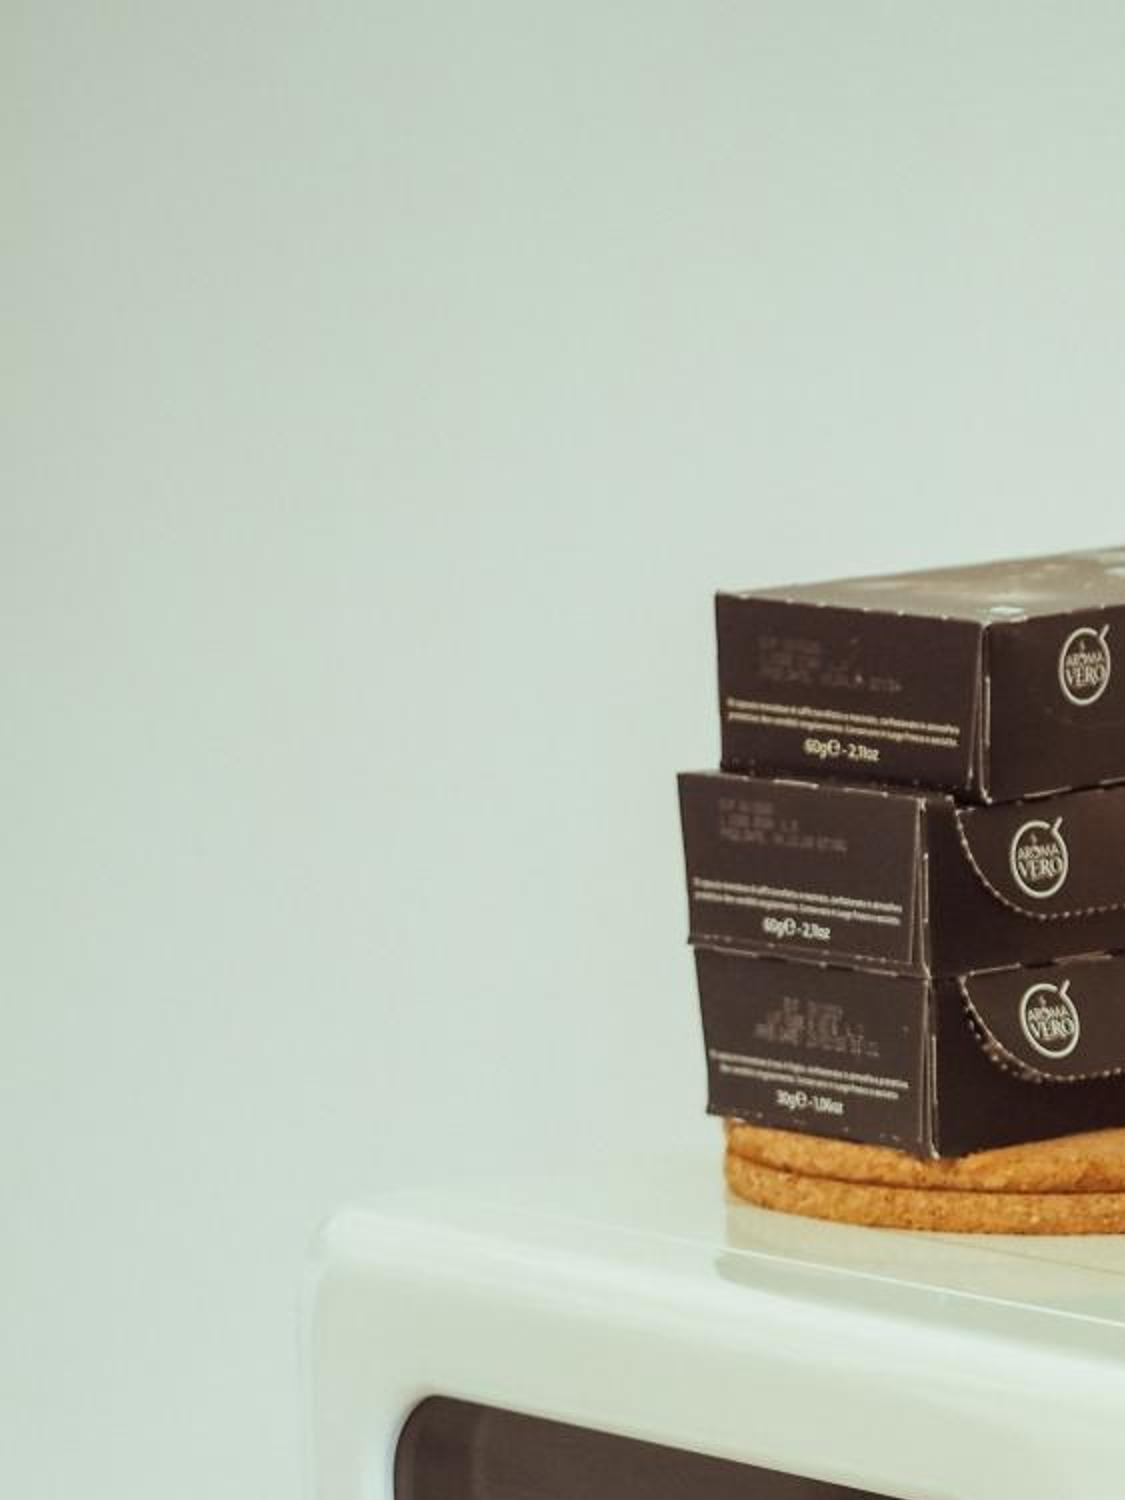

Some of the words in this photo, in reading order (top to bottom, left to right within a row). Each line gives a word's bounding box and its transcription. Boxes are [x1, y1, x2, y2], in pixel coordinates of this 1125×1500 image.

[1065, 663, 1106, 687] VERO
[1018, 844, 1060, 861] AROMA
[1018, 856, 1063, 881] VERO
[1028, 1005, 1071, 1022] AROMA
[1029, 1017, 1075, 1041] VERO
